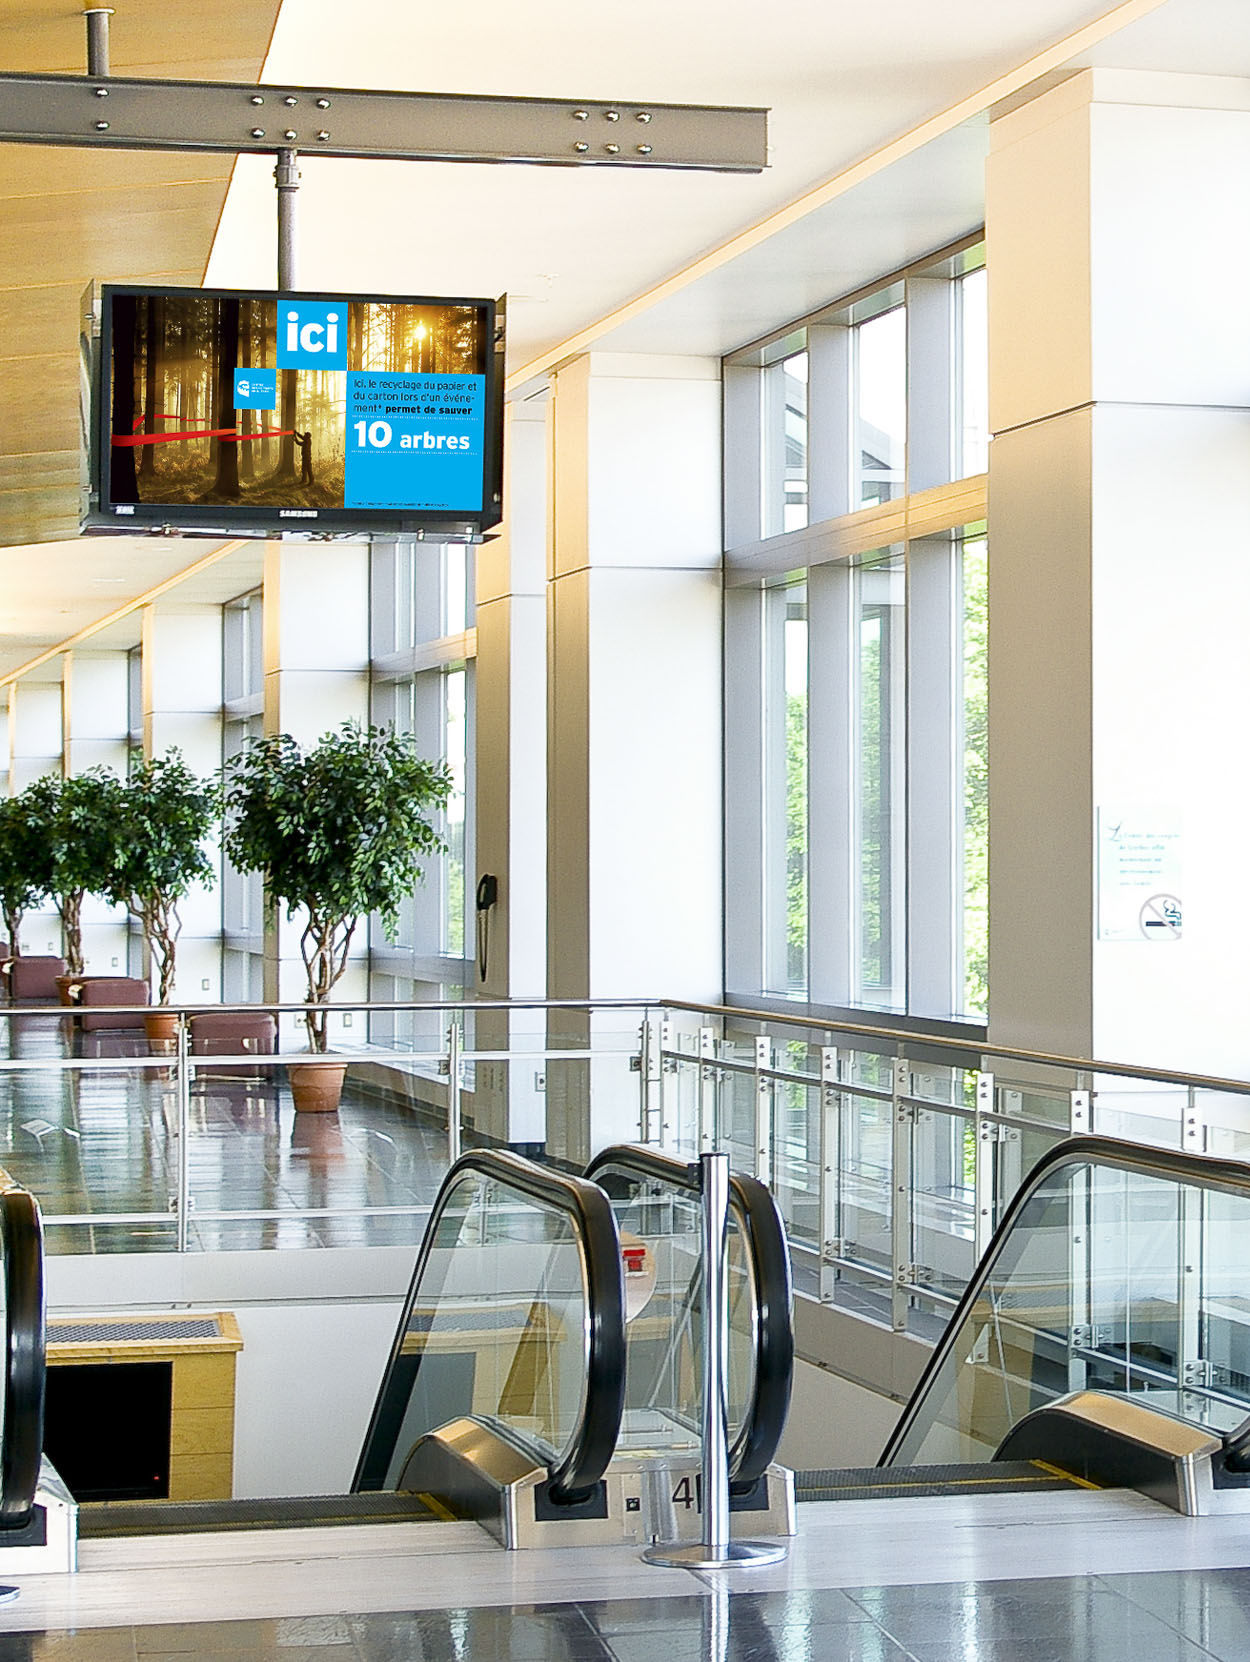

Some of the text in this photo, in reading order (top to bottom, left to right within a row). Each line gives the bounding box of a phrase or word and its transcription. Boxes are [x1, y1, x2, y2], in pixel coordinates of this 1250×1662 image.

[286, 311, 338, 353] ici
[369, 379, 377, 388] le
[379, 380, 421, 391] recyclage
[424, 381, 435, 389] du
[437, 381, 465, 391] papier
[467, 382, 477, 391] et
[353, 391, 475, 403] du carton lors d'un événe-
[385, 405, 421, 414] permet
[439, 407, 473, 415] sauver
[354, 420, 470, 450] 10 arbres
[672, 1477, 694, 1509] 4
